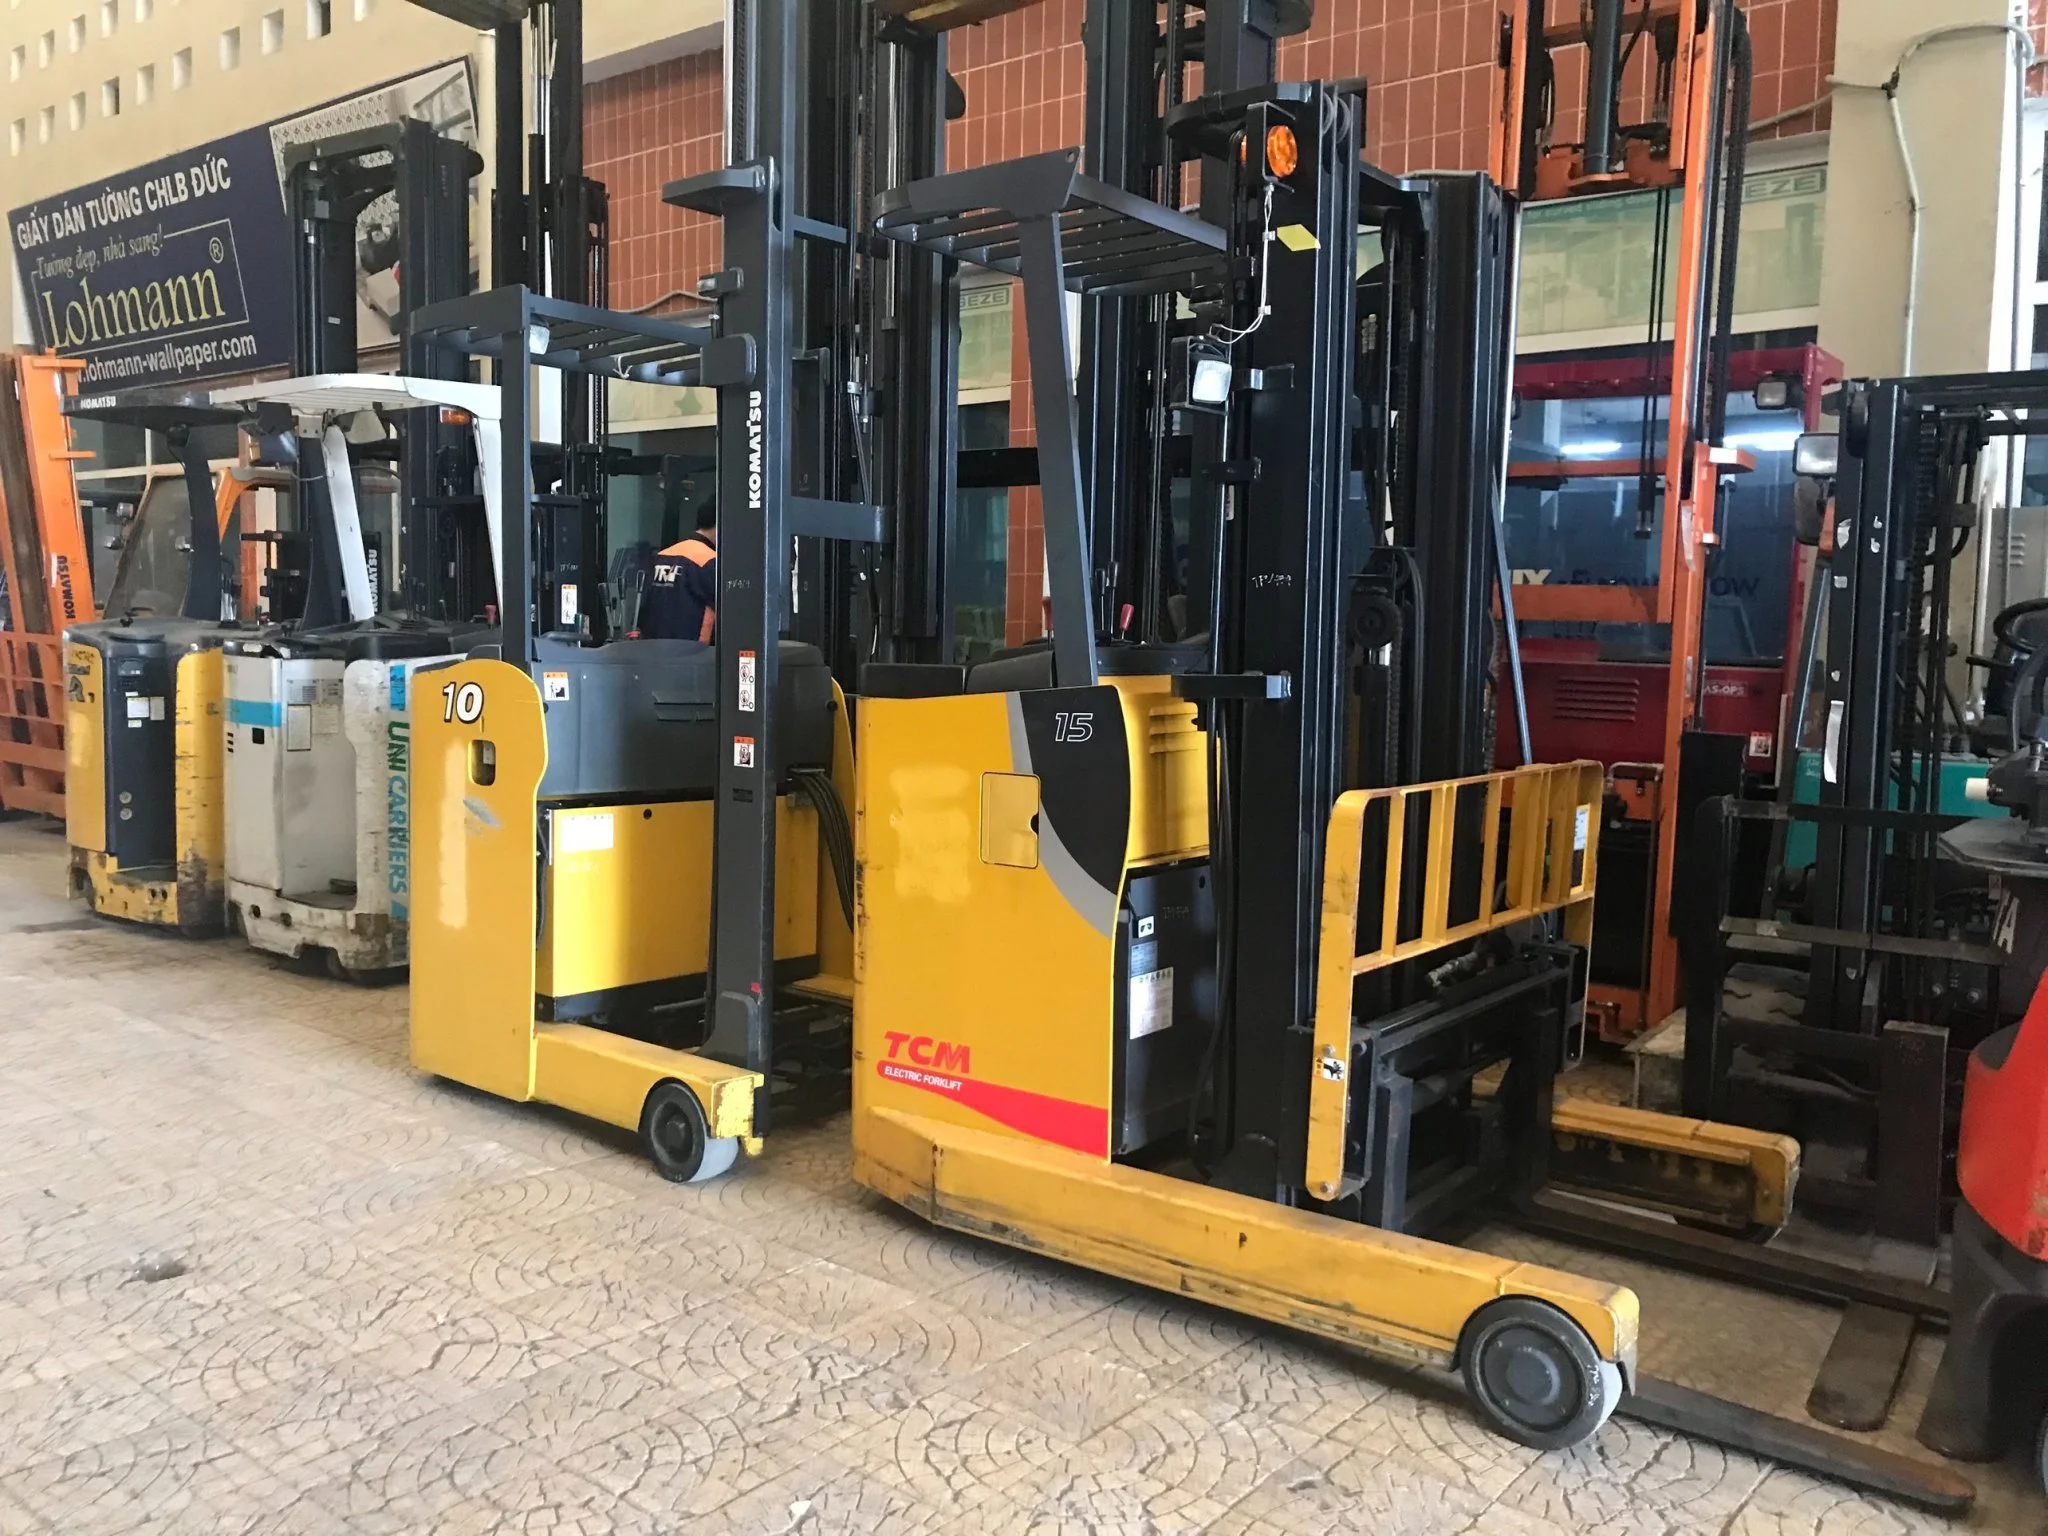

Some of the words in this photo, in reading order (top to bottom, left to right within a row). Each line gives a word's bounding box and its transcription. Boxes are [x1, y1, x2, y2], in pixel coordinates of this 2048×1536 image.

[17, 206, 50, 250] GIẤY
[52, 201, 86, 239] DÁN
[85, 187, 142, 229] TƯỜNG
[144, 171, 188, 211] CHLB
[191, 153, 231, 198] ĐỨC
[1745, 174, 1817, 198] EZE
[129, 223, 164, 256] sang!
[41, 268, 226, 349] Lohmann
[78, 334, 257, 384] .lohmann-wallpaper.com
[746, 390, 762, 509] KOMATSU
[56, 555, 76, 619] KOMATSU
[443, 681, 485, 725] 10
[1055, 712, 1094, 742] 15
[884, 1030, 971, 1074] TCM
[884, 1065, 923, 1082] ELECTRIC
[922, 1074, 963, 1091] FORKLIFT
